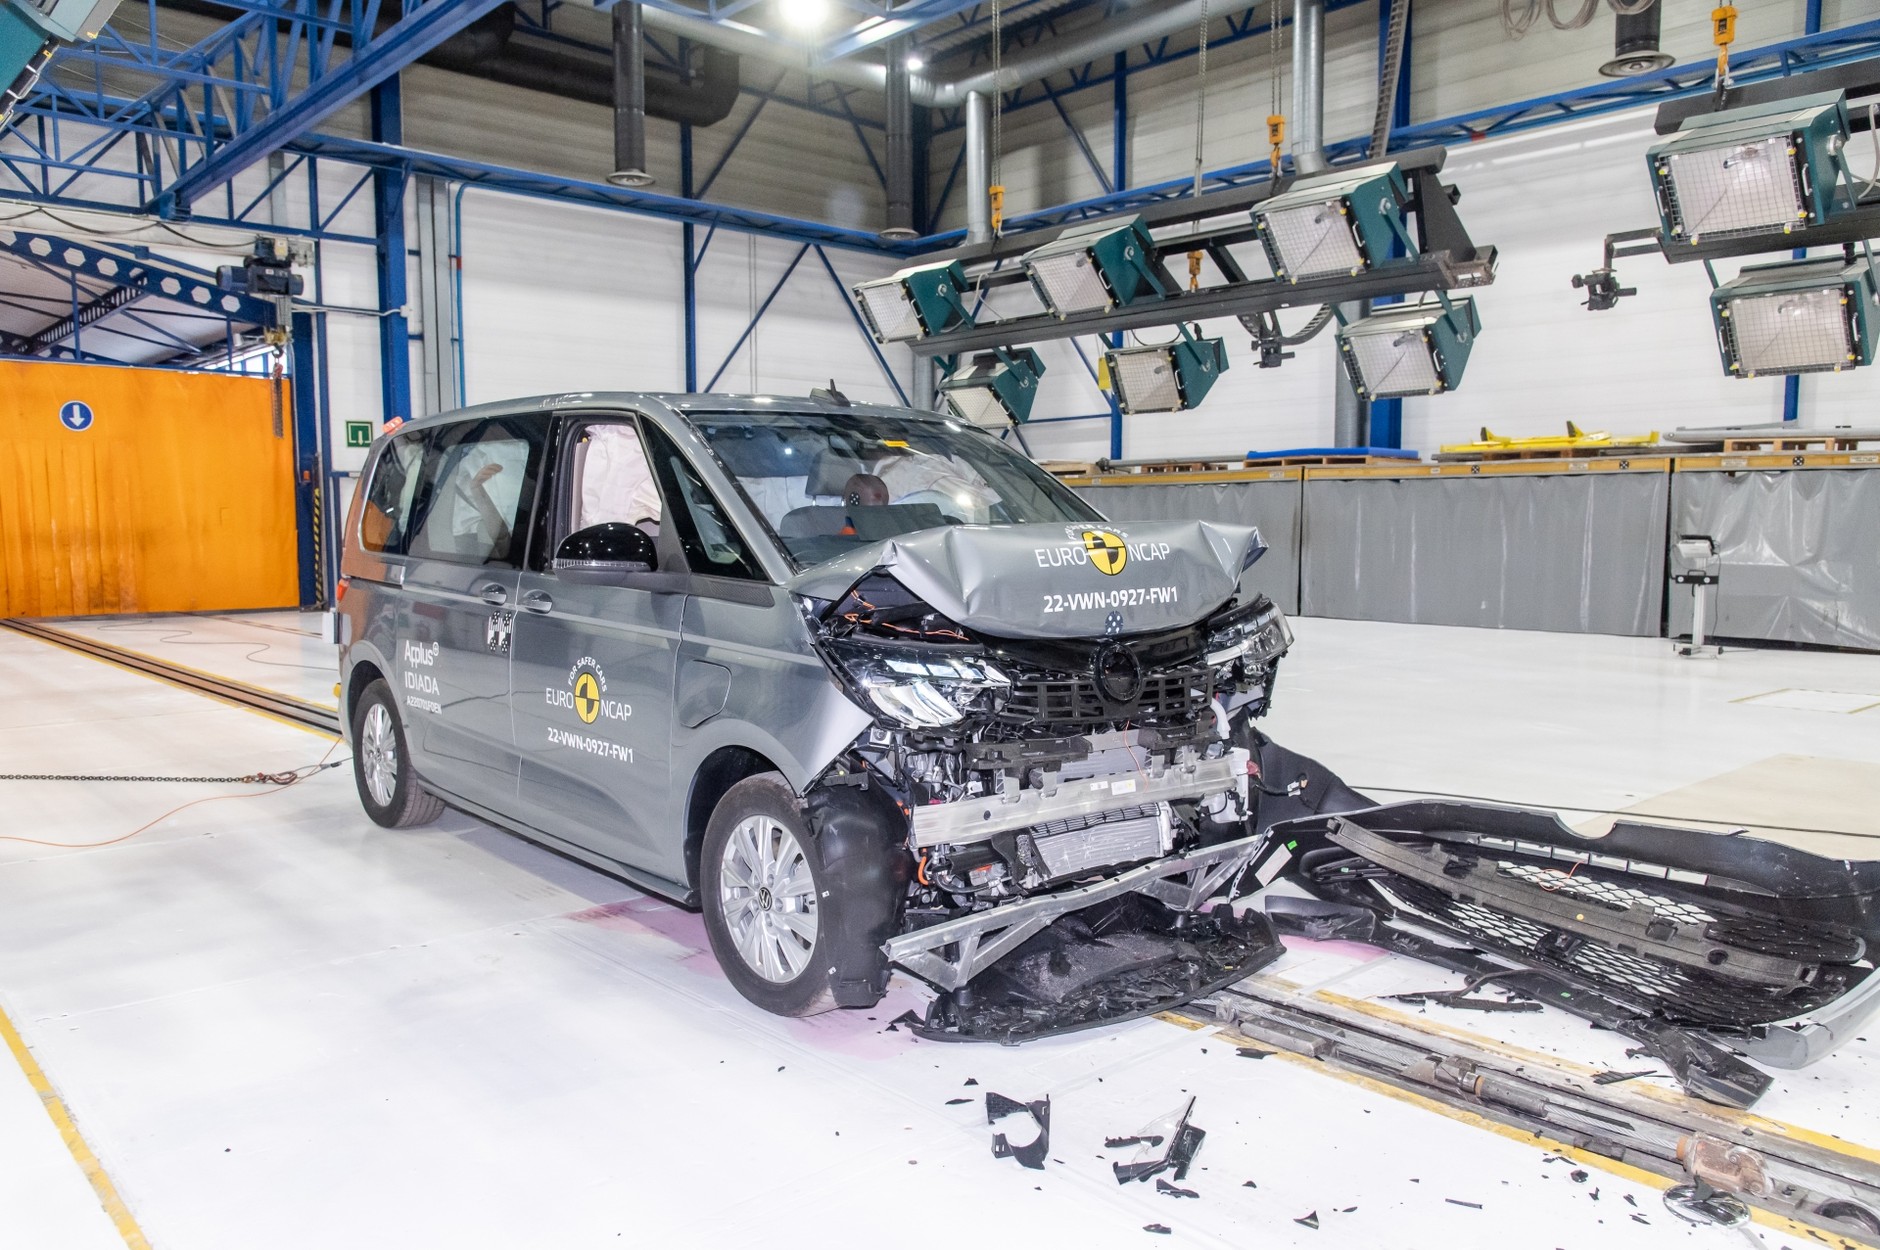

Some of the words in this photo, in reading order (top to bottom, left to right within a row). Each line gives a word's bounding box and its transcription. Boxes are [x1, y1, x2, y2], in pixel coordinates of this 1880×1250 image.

[1097, 524, 1129, 538] CARS
[1034, 546, 1087, 568] EURO
[1128, 542, 1171, 562] NCAP
[1043, 586, 1179, 614] 22-VWN-0927-FW1
[404, 671, 441, 696] IDIADA
[567, 666, 578, 687] FOR
[576, 656, 596, 669] SAFER
[595, 664, 608, 693] CARS
[545, 687, 574, 709] EURO
[601, 699, 633, 722] NCAP
[547, 727, 634, 764] 22-VWN-0927-FW1
